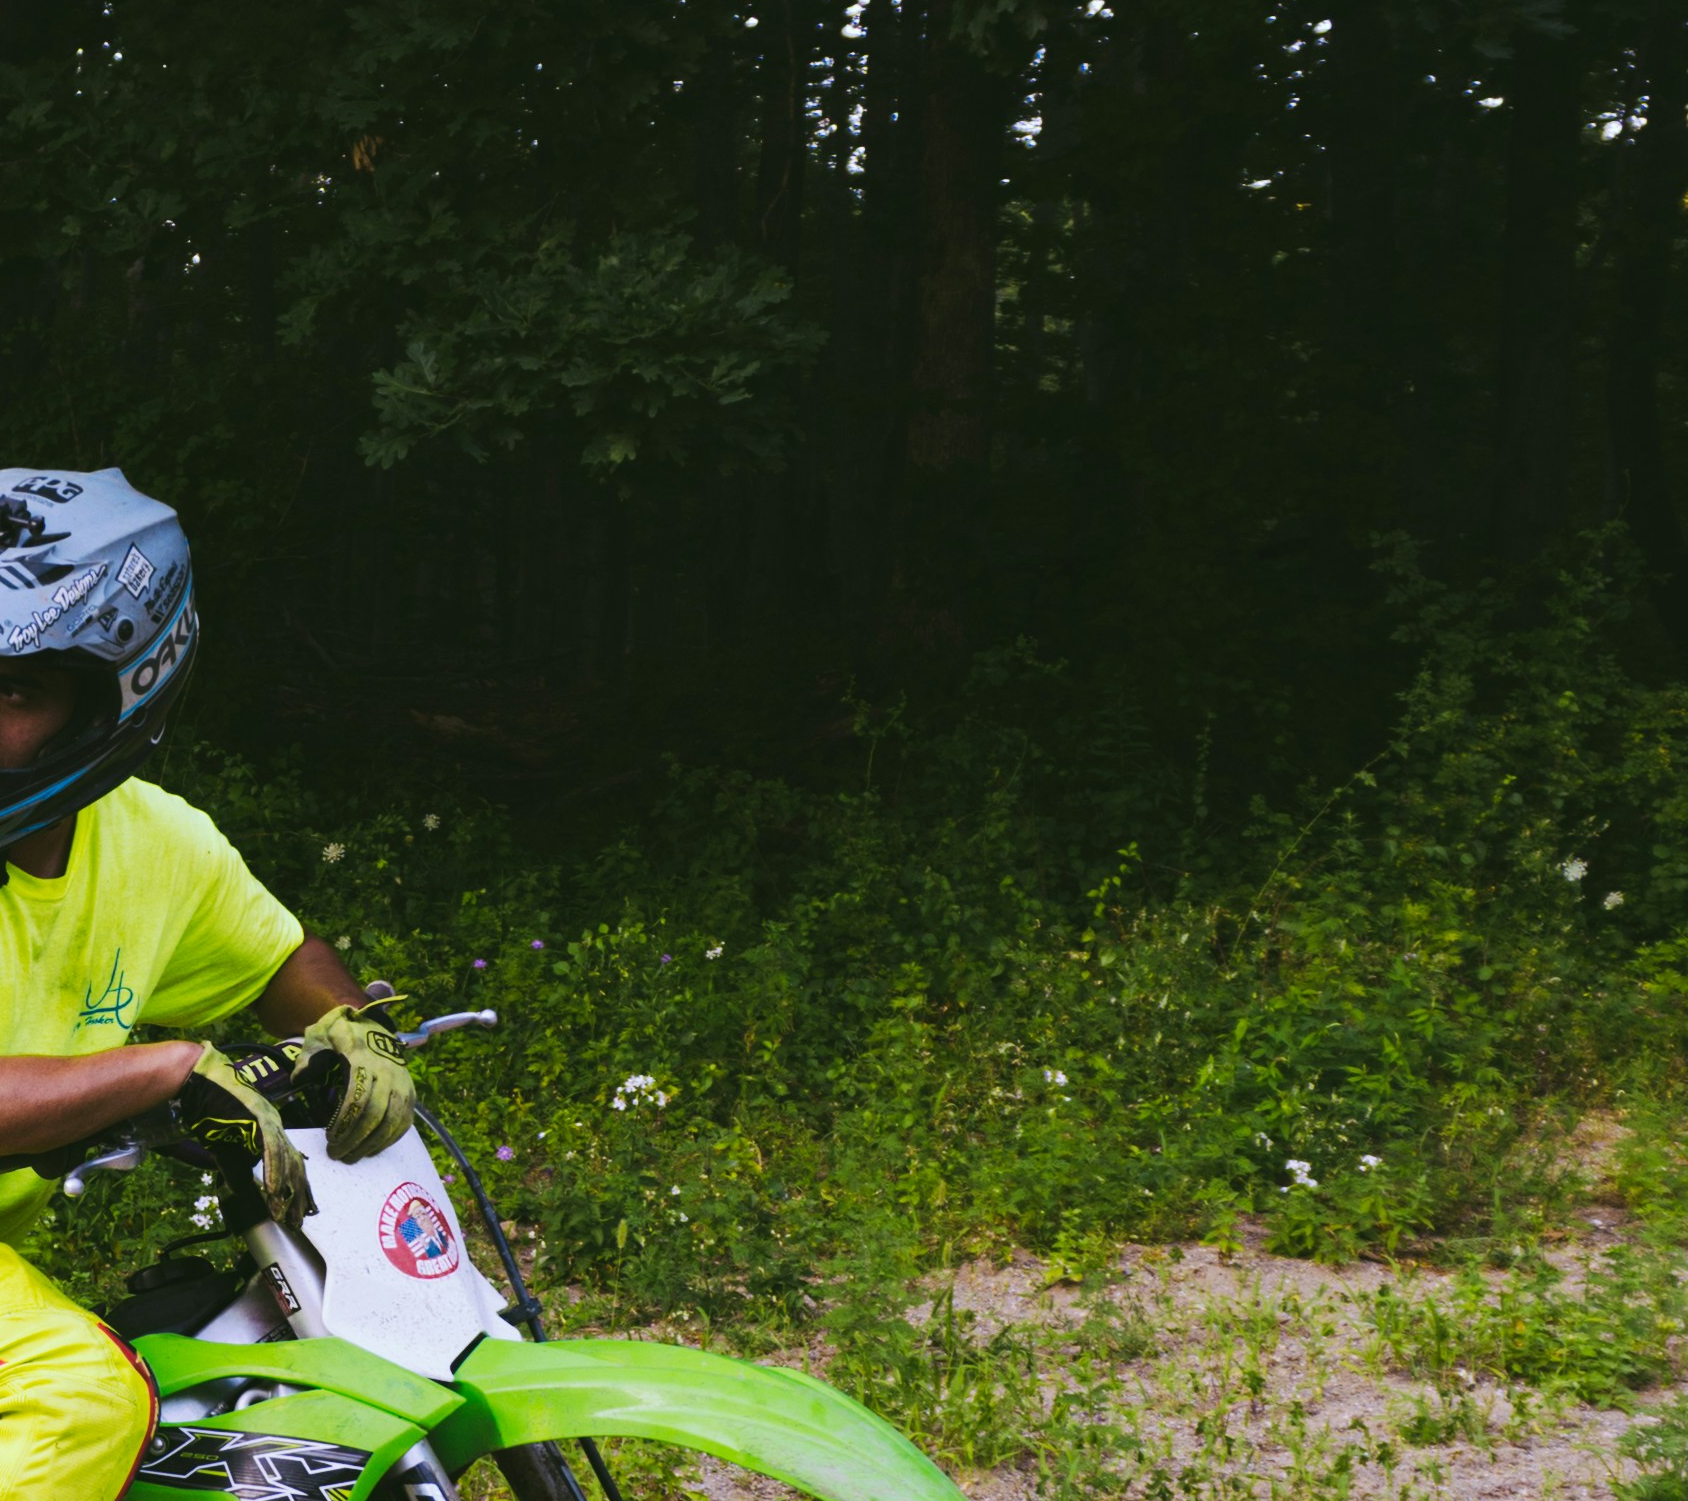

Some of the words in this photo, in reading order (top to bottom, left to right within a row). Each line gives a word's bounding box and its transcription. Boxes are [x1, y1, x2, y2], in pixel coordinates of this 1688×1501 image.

[7, 624, 41, 653] Troy
[32, 611, 62, 634] Lee
[52, 564, 108, 613] Designs
[379, 1204, 399, 1249] MAKE
[416, 1254, 454, 1276] GREAT
[269, 1266, 300, 1310] GRR
[179, 1452, 220, 1462] 250
